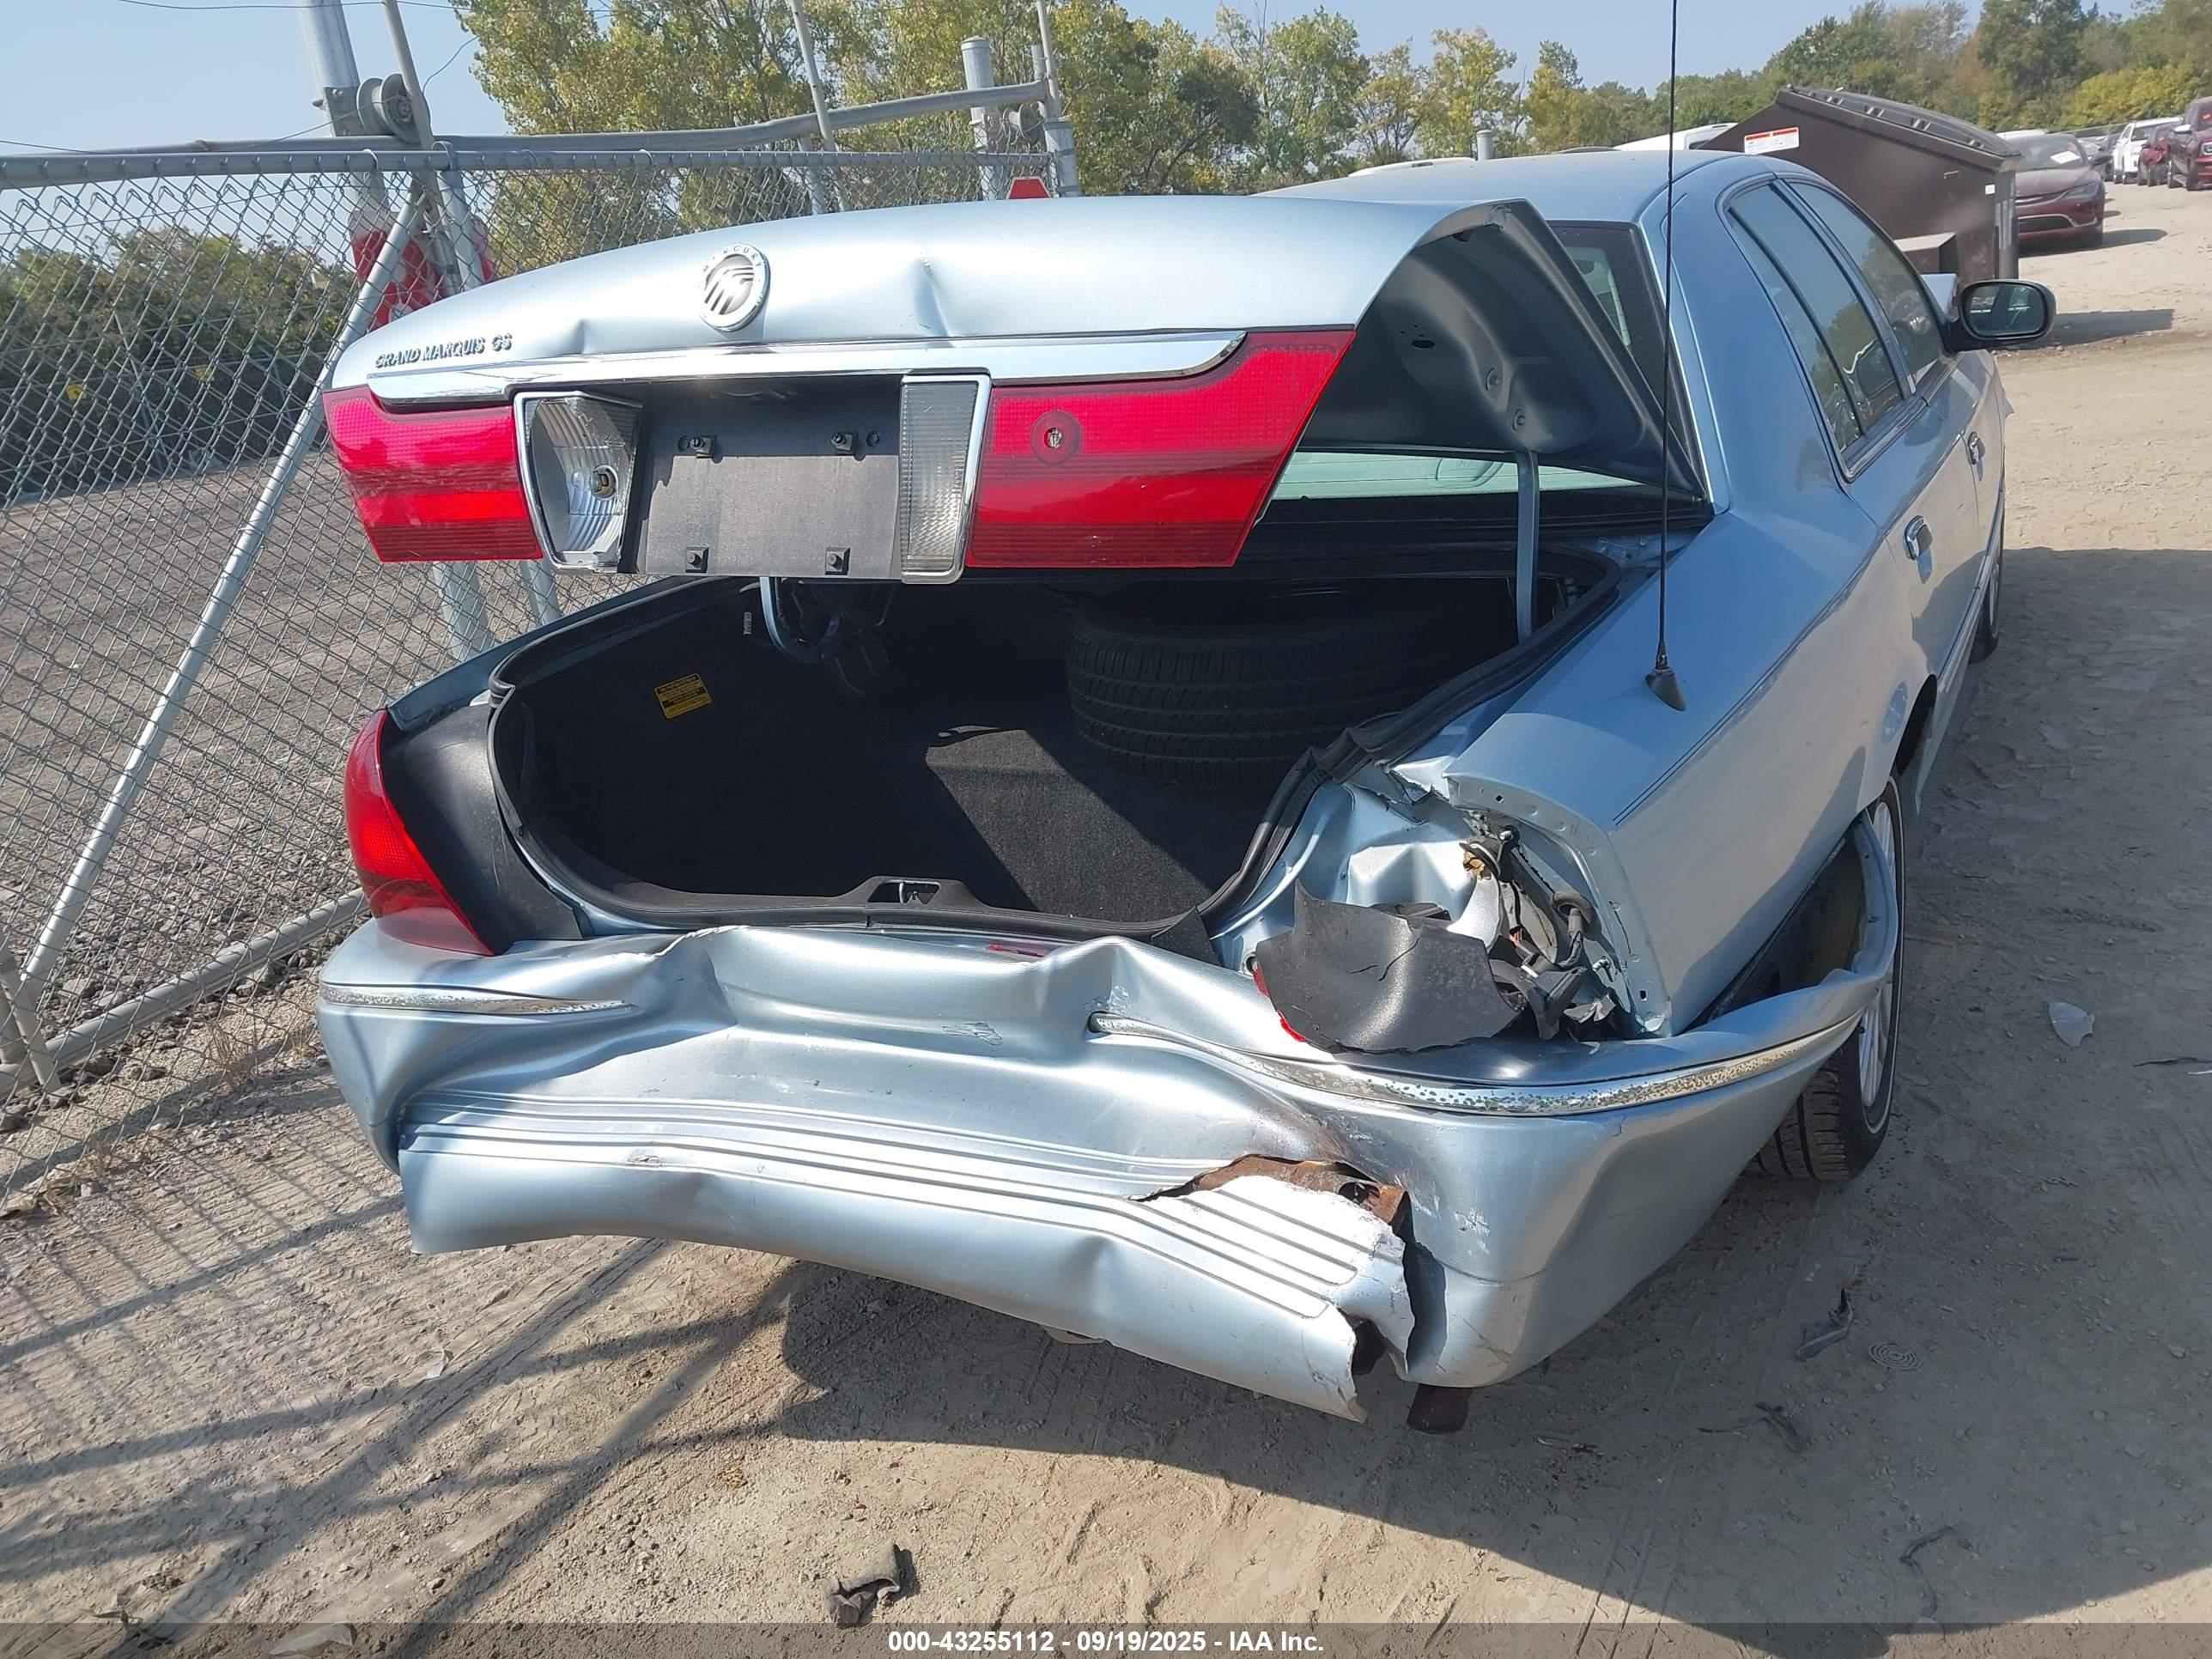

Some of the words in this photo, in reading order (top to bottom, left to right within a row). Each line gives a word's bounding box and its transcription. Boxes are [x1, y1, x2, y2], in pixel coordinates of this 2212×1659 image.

[702, 244, 763, 273] MRCURY
[374, 347, 421, 369] GRAND
[422, 337, 486, 362] MARQUIS
[491, 332, 513, 352] GS
